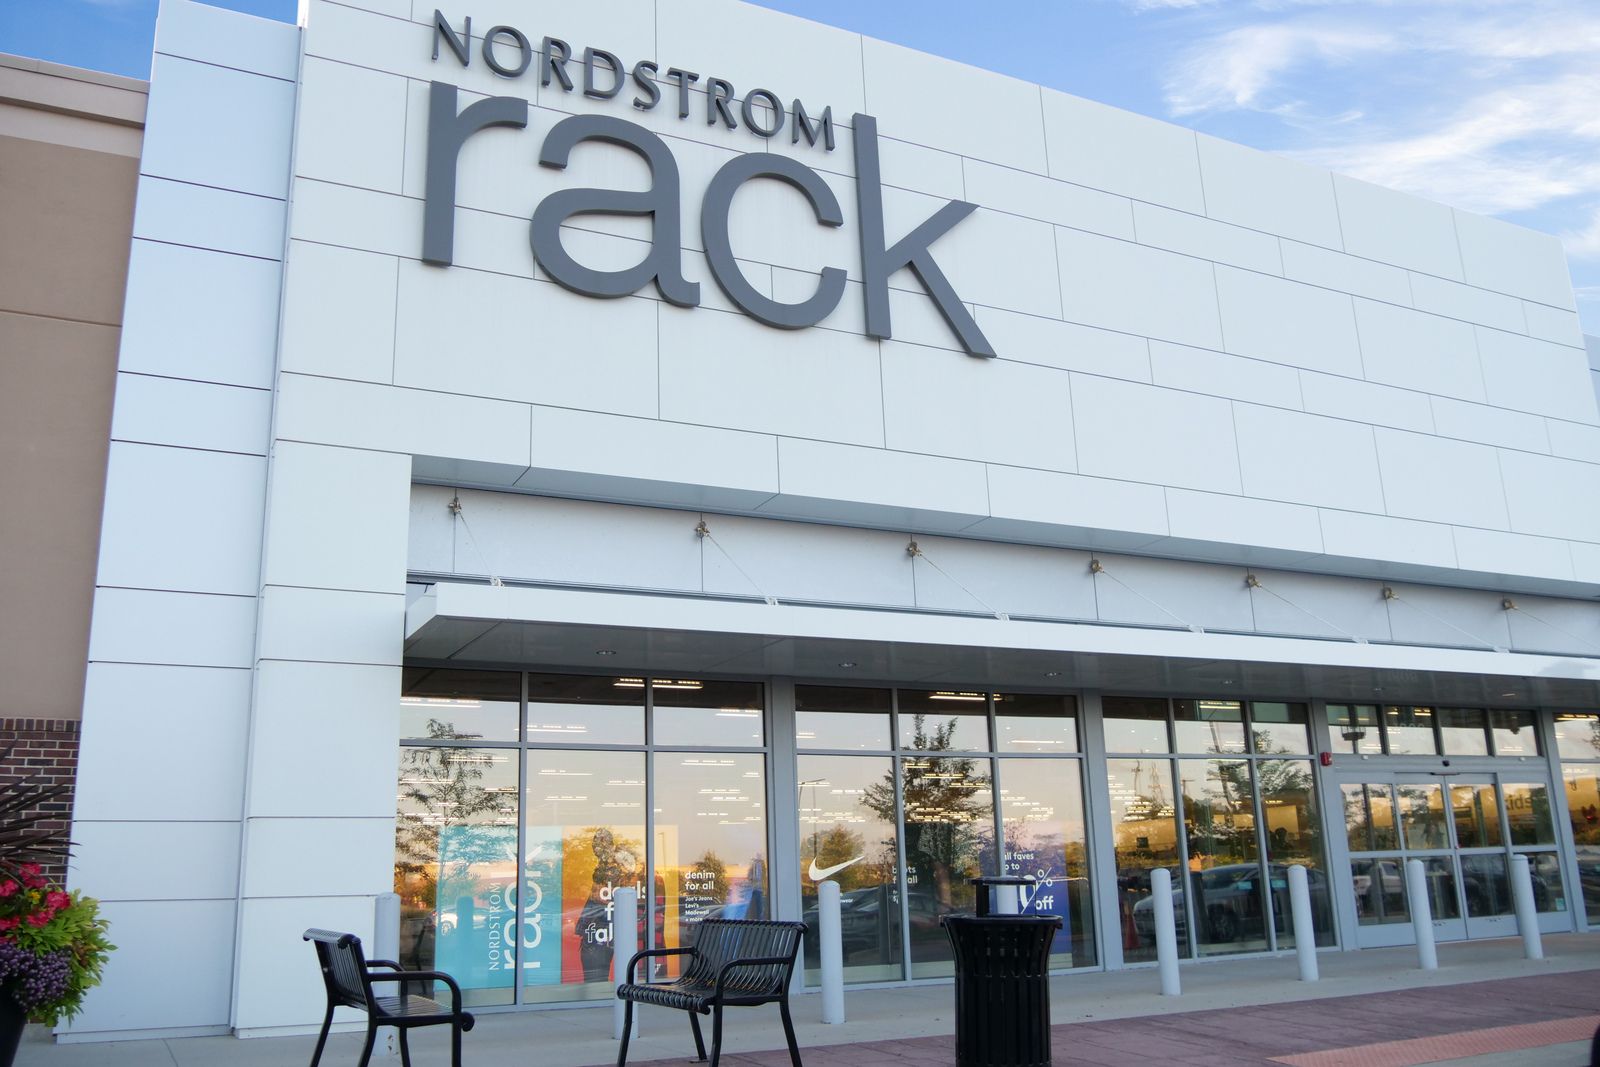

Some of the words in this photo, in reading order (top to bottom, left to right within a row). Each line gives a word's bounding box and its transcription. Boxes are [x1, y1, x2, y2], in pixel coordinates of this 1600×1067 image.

[431, 9, 836, 152] NORDSTROM
[422, 80, 997, 359] rack
[1013, 851, 1035, 860] faves
[685, 870, 715, 879] denim
[1011, 862, 1020, 870] to
[600, 880, 646, 900] dls
[685, 881, 699, 890] for
[702, 881, 714, 890] all
[490, 845, 542, 969] rack
[1035, 895, 1054, 910] off
[488, 882, 501, 970] NORDSTROM
[585, 923, 613, 943] fal
